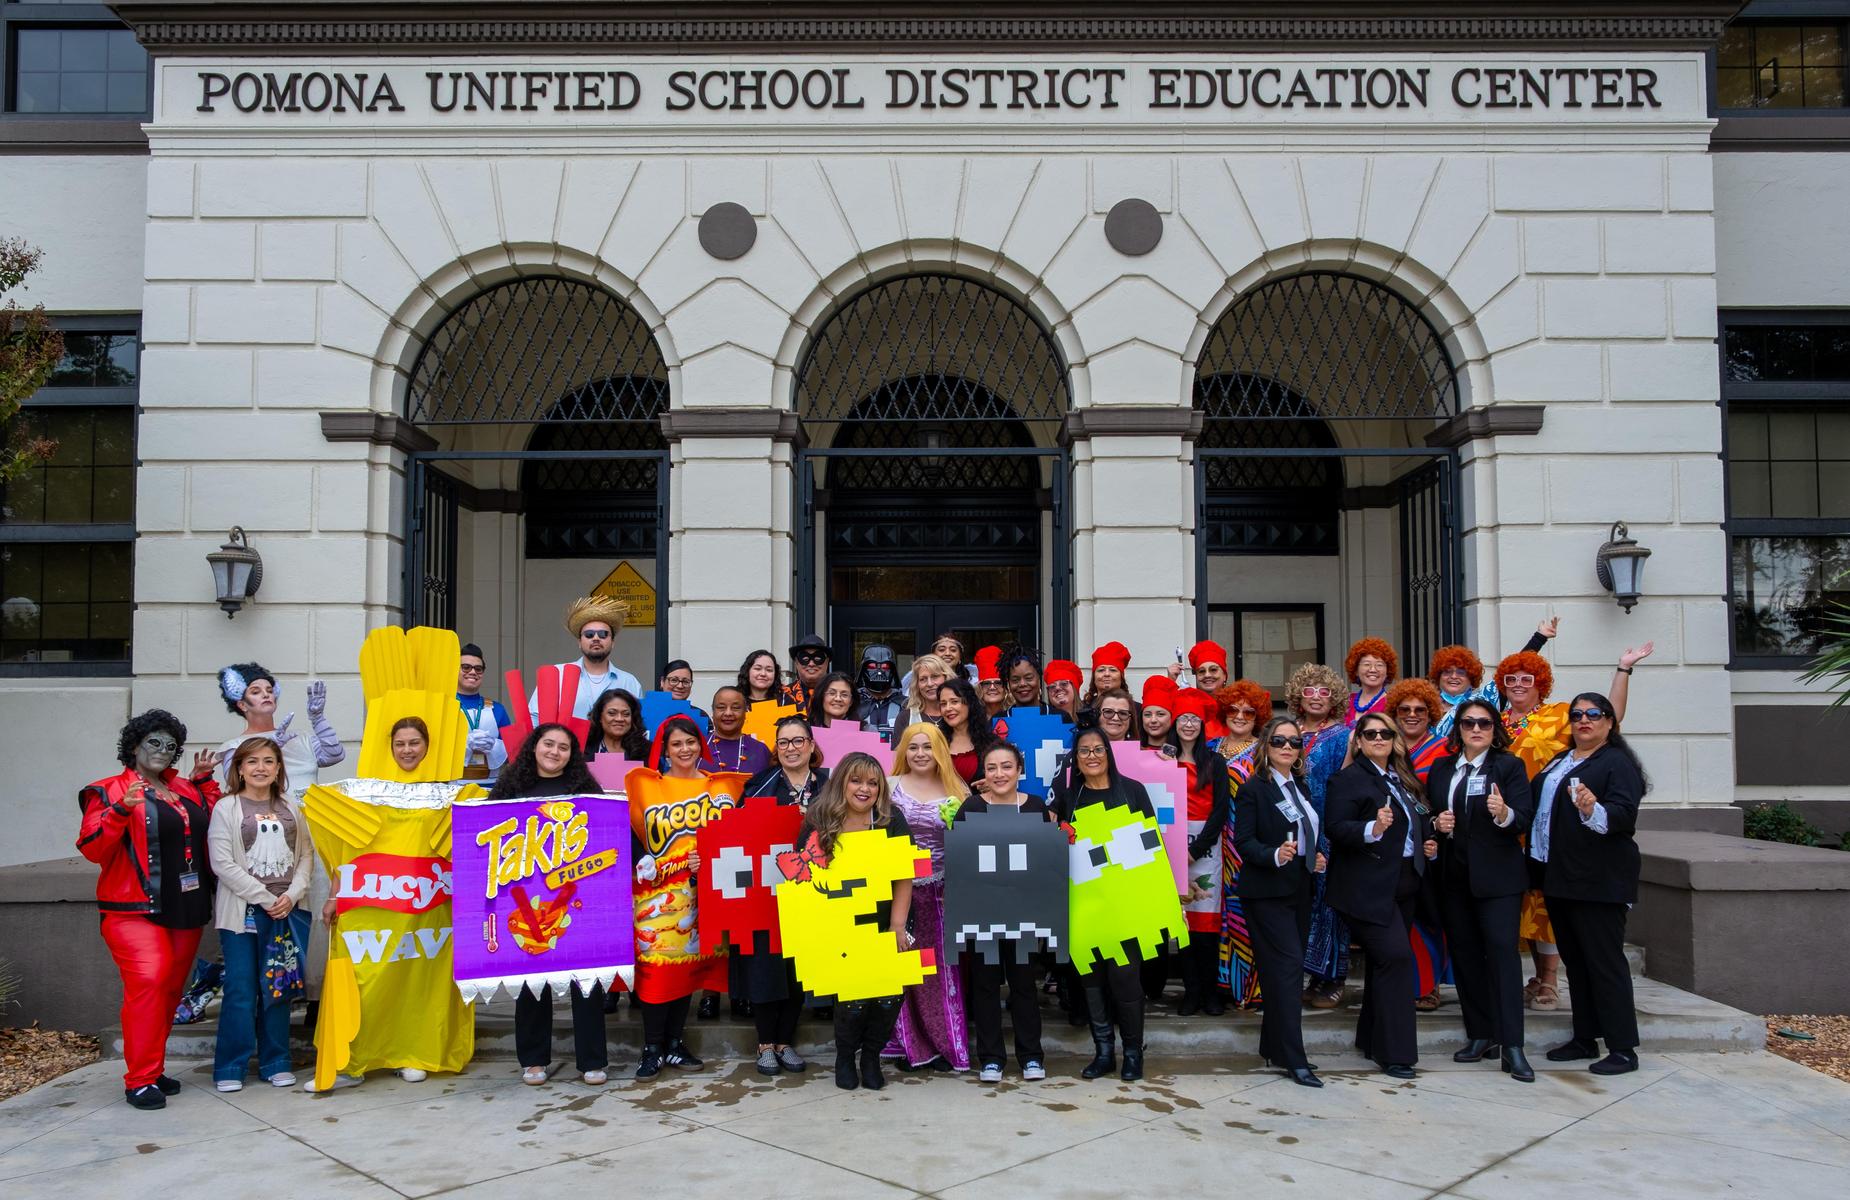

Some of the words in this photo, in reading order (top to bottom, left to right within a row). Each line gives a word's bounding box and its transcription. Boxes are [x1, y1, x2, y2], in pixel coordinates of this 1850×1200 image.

[197, 71, 405, 113] POMONA
[426, 70, 641, 112] UNIFIED
[665, 69, 864, 111] SCHOOL
[886, 68, 1125, 110] DISTRICT
[1149, 67, 1430, 109] EDUCATION
[1452, 67, 1662, 109] CENTER
[607, 580, 642, 588] TOBACCO
[558, 857, 604, 884] FUEGO
